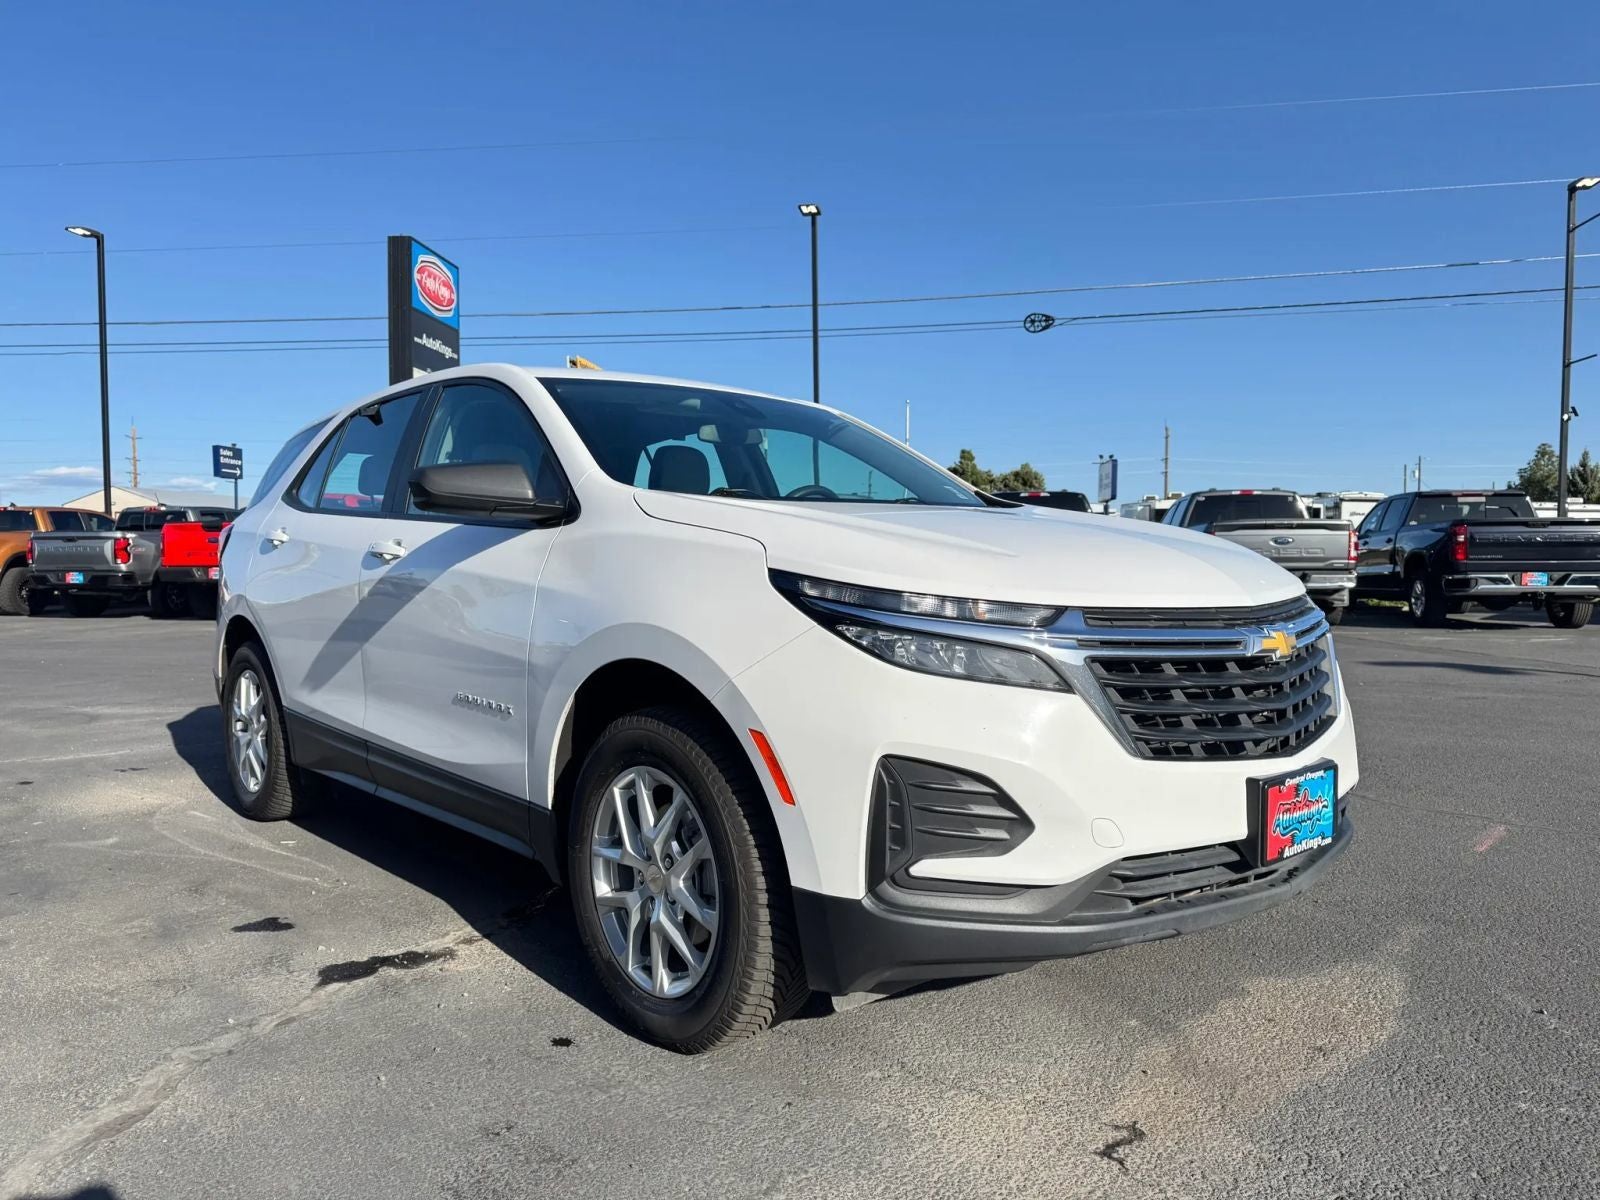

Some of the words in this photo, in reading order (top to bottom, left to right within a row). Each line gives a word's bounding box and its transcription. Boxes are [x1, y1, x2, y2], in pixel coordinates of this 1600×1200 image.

[219, 448, 233, 457] Sales
[220, 456, 242, 466] Entrance
[456, 691, 515, 716] EQUINOX
[1285, 773, 1306, 787] Central
[1283, 835, 1333, 859] AutoKings.com
